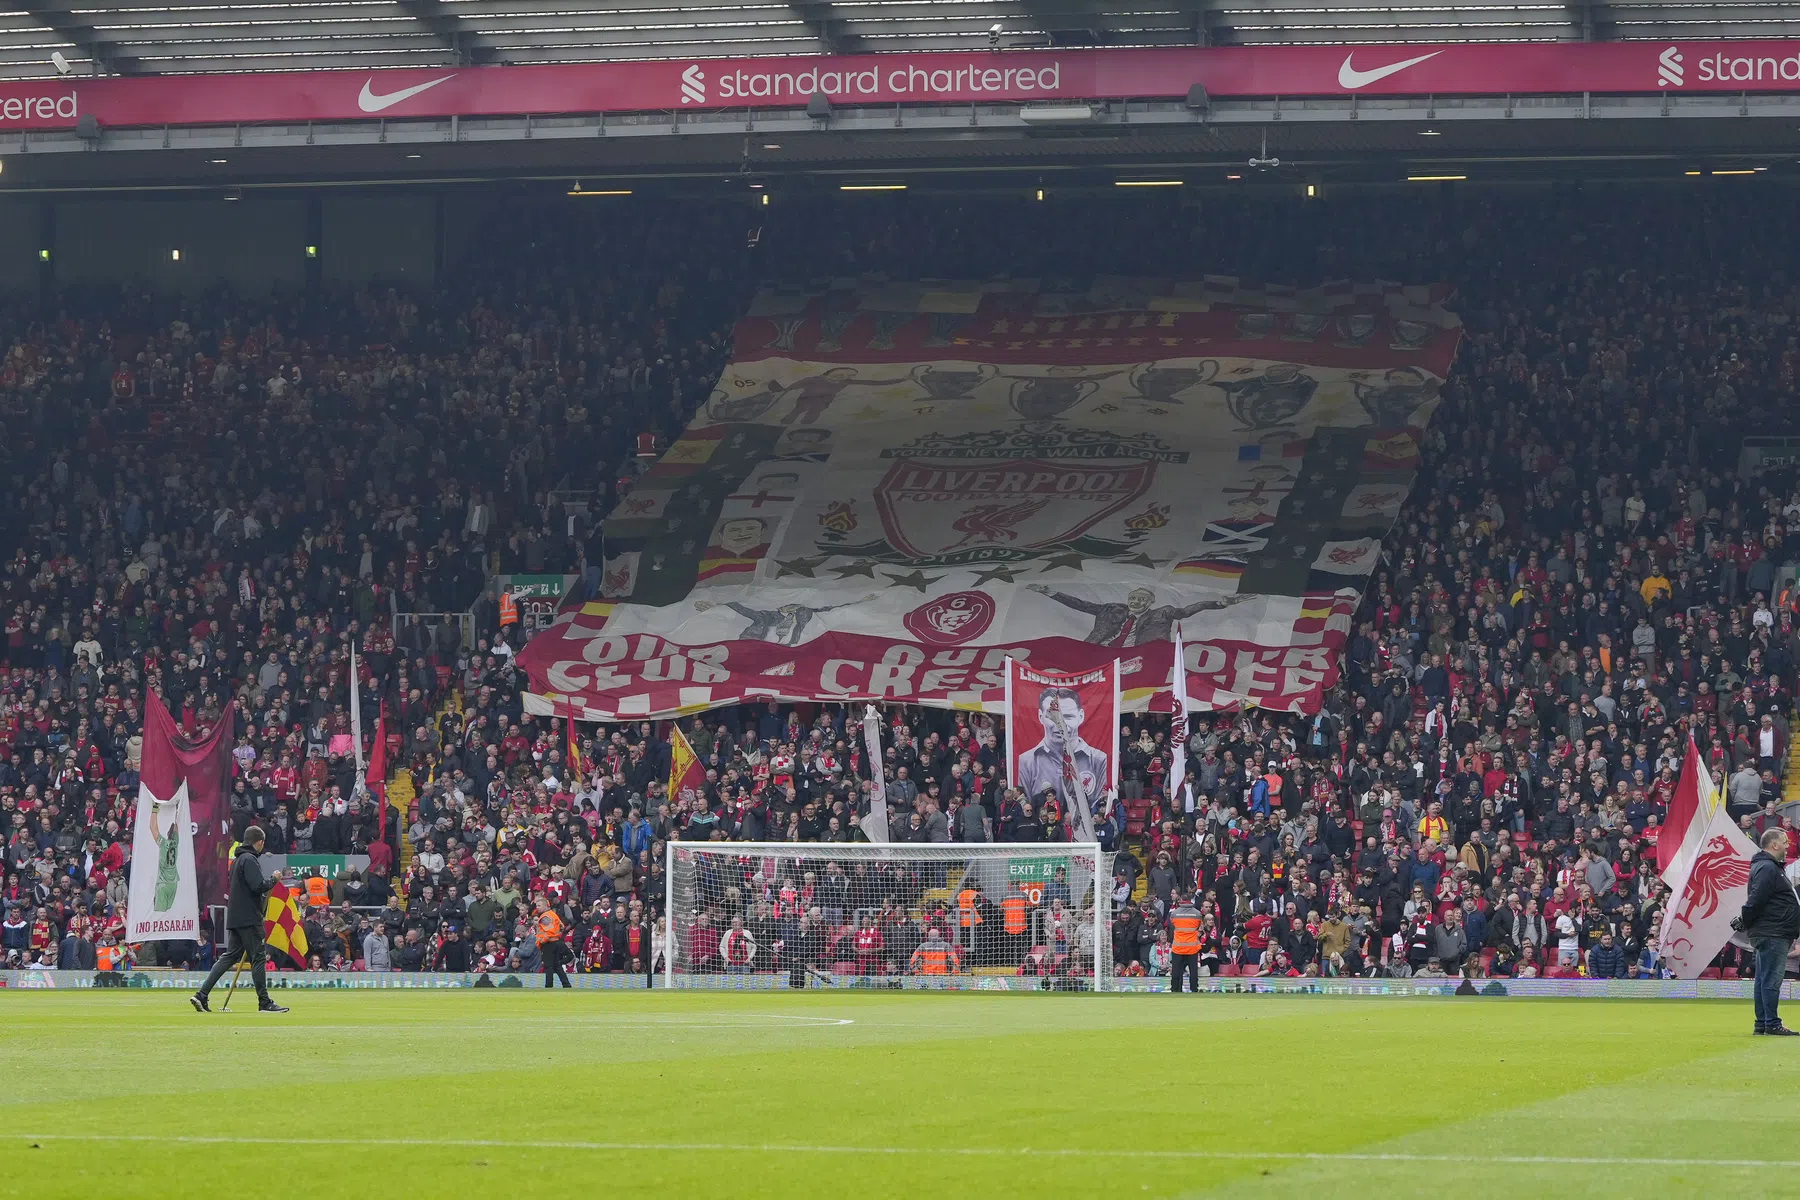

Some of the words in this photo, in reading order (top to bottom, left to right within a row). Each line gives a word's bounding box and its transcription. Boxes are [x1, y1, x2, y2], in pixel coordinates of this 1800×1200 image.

[719, 65, 879, 98] standard
[888, 62, 1060, 94] chartered
[965, 449, 1037, 458] NEVER
[1046, 444, 1109, 459] WALK
[1113, 446, 1182, 464] ALONE
[901, 470, 1134, 494] LIVERPOOL
[819, 658, 1010, 697] CRES
[1009, 864, 1036, 875] EXIT
